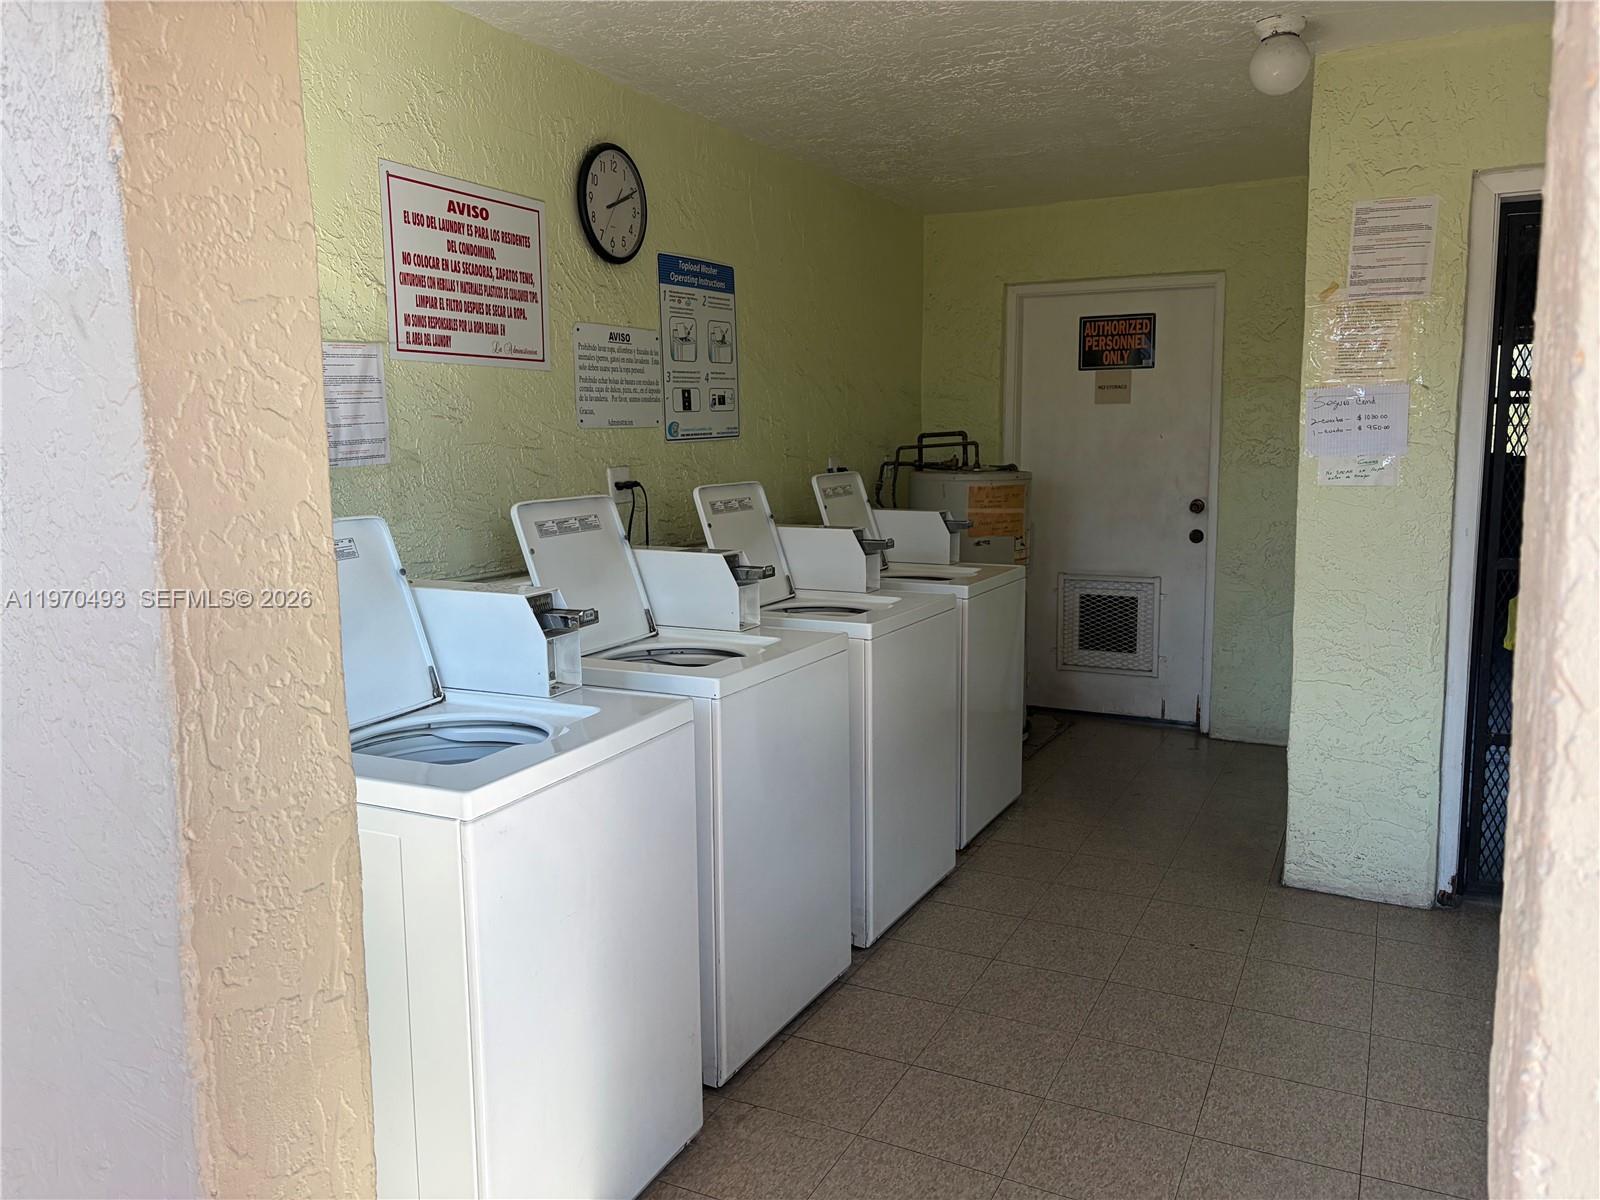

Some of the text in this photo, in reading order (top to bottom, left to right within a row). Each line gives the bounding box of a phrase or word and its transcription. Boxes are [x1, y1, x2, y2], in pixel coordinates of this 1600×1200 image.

[599, 160, 606, 174] 11
[610, 159, 618, 174] 12
[591, 172, 598, 186] 10
[623, 169, 626, 181] 1
[588, 191, 594, 203] 9
[447, 200, 489, 220] AVISO
[591, 211, 596, 223] 8
[632, 207, 636, 219] 3
[403, 210, 530, 248] EL USO DEL LAUNDRY ES PARA LOS RESIDENTES
[599, 229, 604, 240] 7
[628, 224, 633, 235] 4
[610, 237, 615, 249] 6
[621, 236, 626, 248] 5
[447, 239, 496, 260] DEL CONDOMINIO.
[402, 251, 535, 288] NO COLOCAR EN LAS SECADORAS, ZAPATOS TENIS,
[679, 260, 718, 275] Topload Washer
[400, 272, 538, 304] CINTURONES CON HEBILLAS Y MATERIALES PLASTICOS DE CUALQUIER TIPO.
[670, 272, 726, 290] Operating Instructions
[416, 294, 528, 320] LIMPIAR EL FILTRO DESPUES DE SECAR LA ROPA.
[702, 296, 706, 306] 2
[404, 313, 506, 336] NO SOMOS RESPONSABLES POR LA ROPA DEJADA EN
[1085, 320, 1150, 336] AUTHORIZED
[406, 331, 452, 348] EL AREA DEL LAUNDRY
[608, 332, 630, 342] AVISO
[1086, 335, 1149, 350] PERSONNEL
[578, 342, 597, 351] Prohibido
[1103, 350, 1129, 365] ONLY
[666, 371, 670, 382] 3
[705, 372, 709, 383] 4
